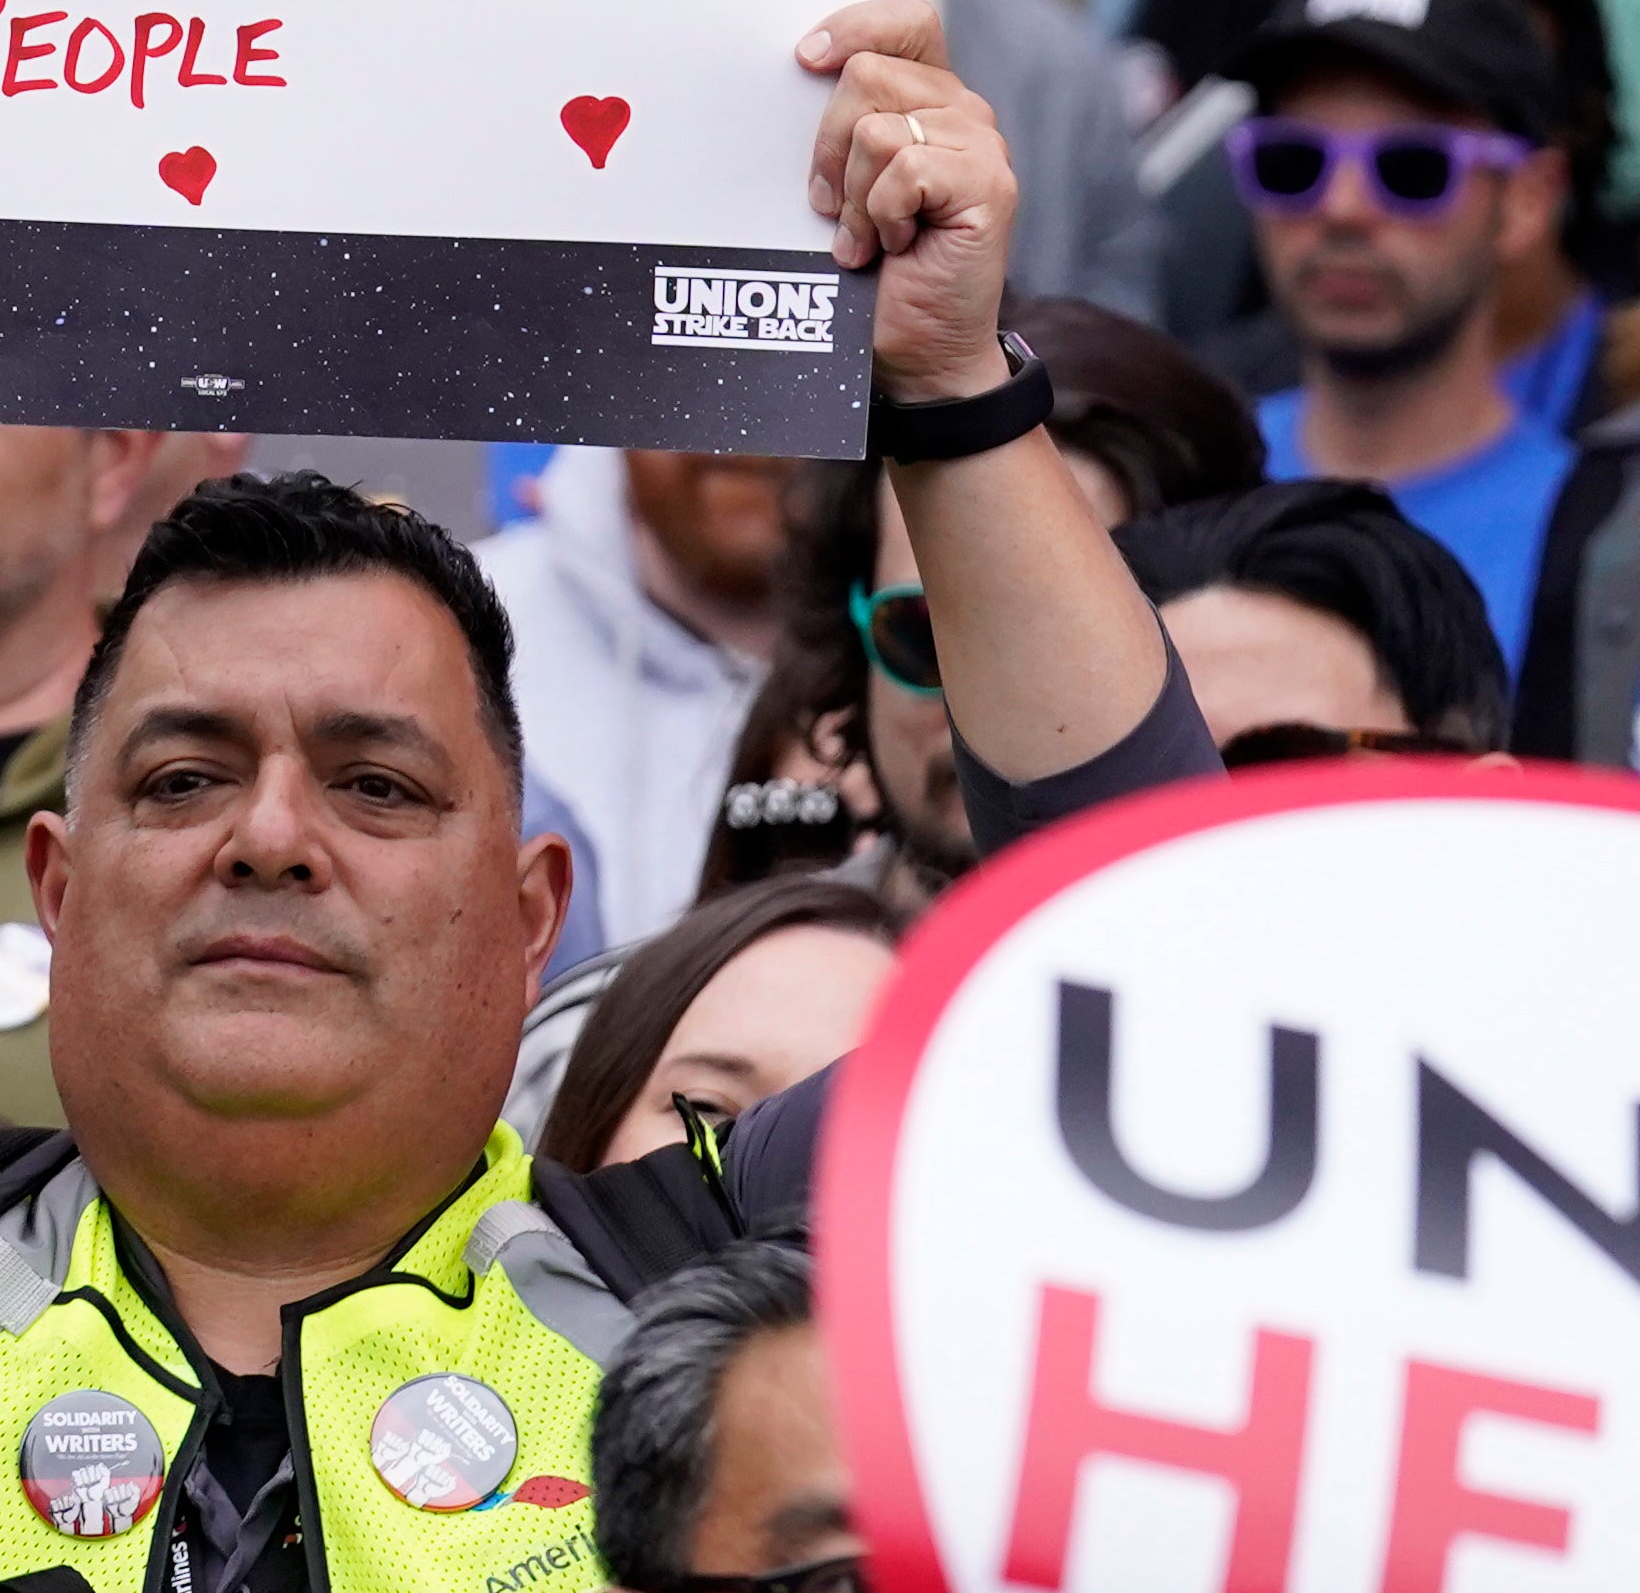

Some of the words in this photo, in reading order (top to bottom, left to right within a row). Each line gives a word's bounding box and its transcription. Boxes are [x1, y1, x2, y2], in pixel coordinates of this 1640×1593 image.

[654, 277, 839, 321] UNIONS
[653, 312, 749, 338] STRIKE
[758, 317, 834, 341] BACK
[43, 1409, 138, 1427] SOLIDARITY
[426, 1388, 497, 1462] WRITERS
[443, 1375, 516, 1445] SOLIDARITY
[44, 1433, 138, 1454] WRITERS
[171, 1541, 192, 1593] rlines
